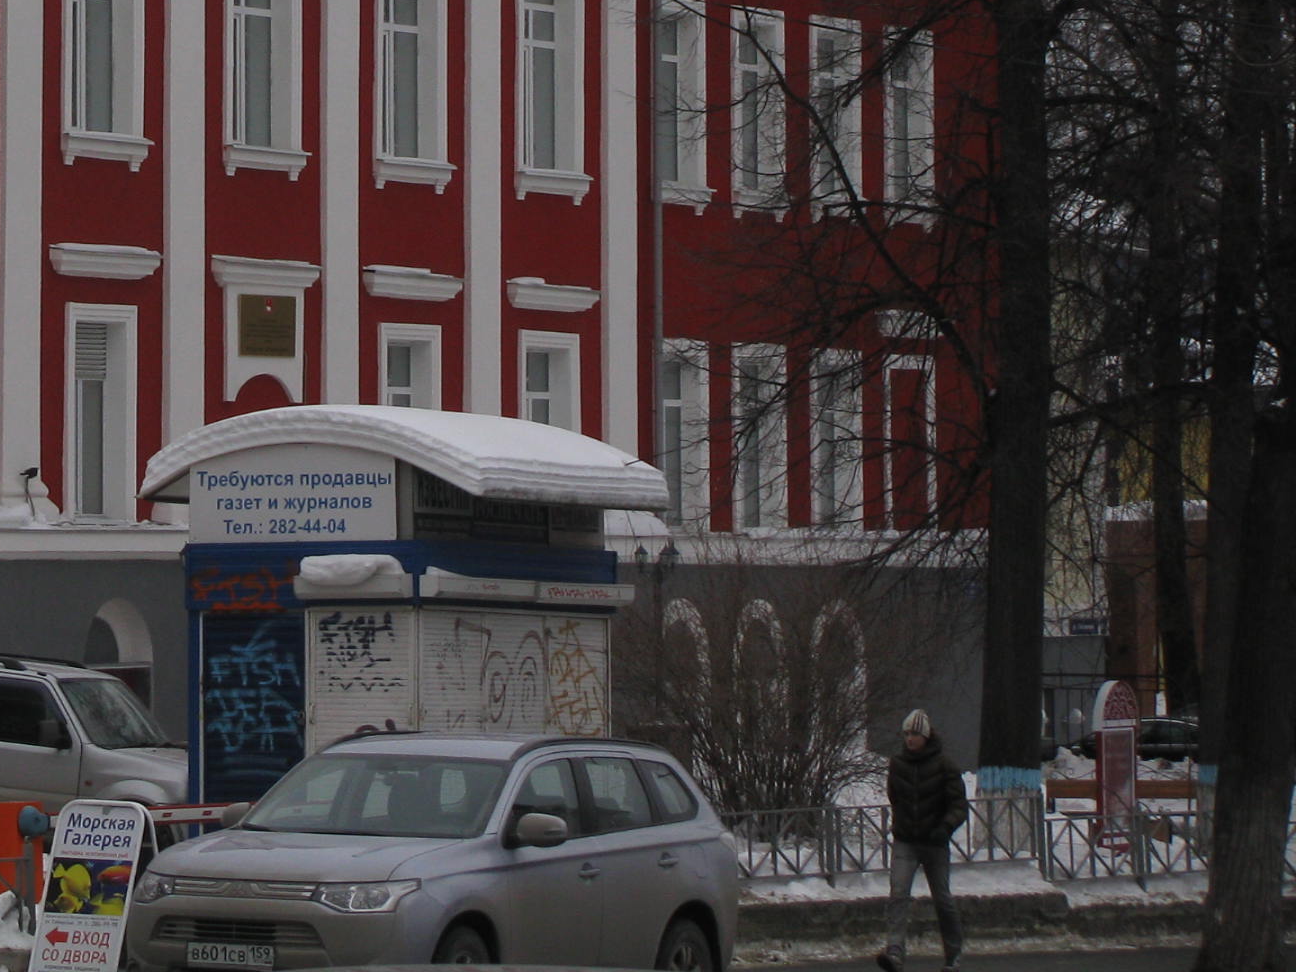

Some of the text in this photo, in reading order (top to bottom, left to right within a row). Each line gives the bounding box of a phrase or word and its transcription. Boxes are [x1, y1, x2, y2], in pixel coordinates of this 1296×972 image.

[197, 471, 392, 490] Требуются продавцы
[216, 496, 372, 513] газет и журналов
[224, 519, 346, 534] Тел.: 282-44-04
[67, 812, 135, 832] Морская
[64, 829, 132, 850] Галерея
[71, 930, 111, 948] ВХОД
[42, 948, 107, 965] СО ДВОРА
[249, 946, 271, 962] 159
